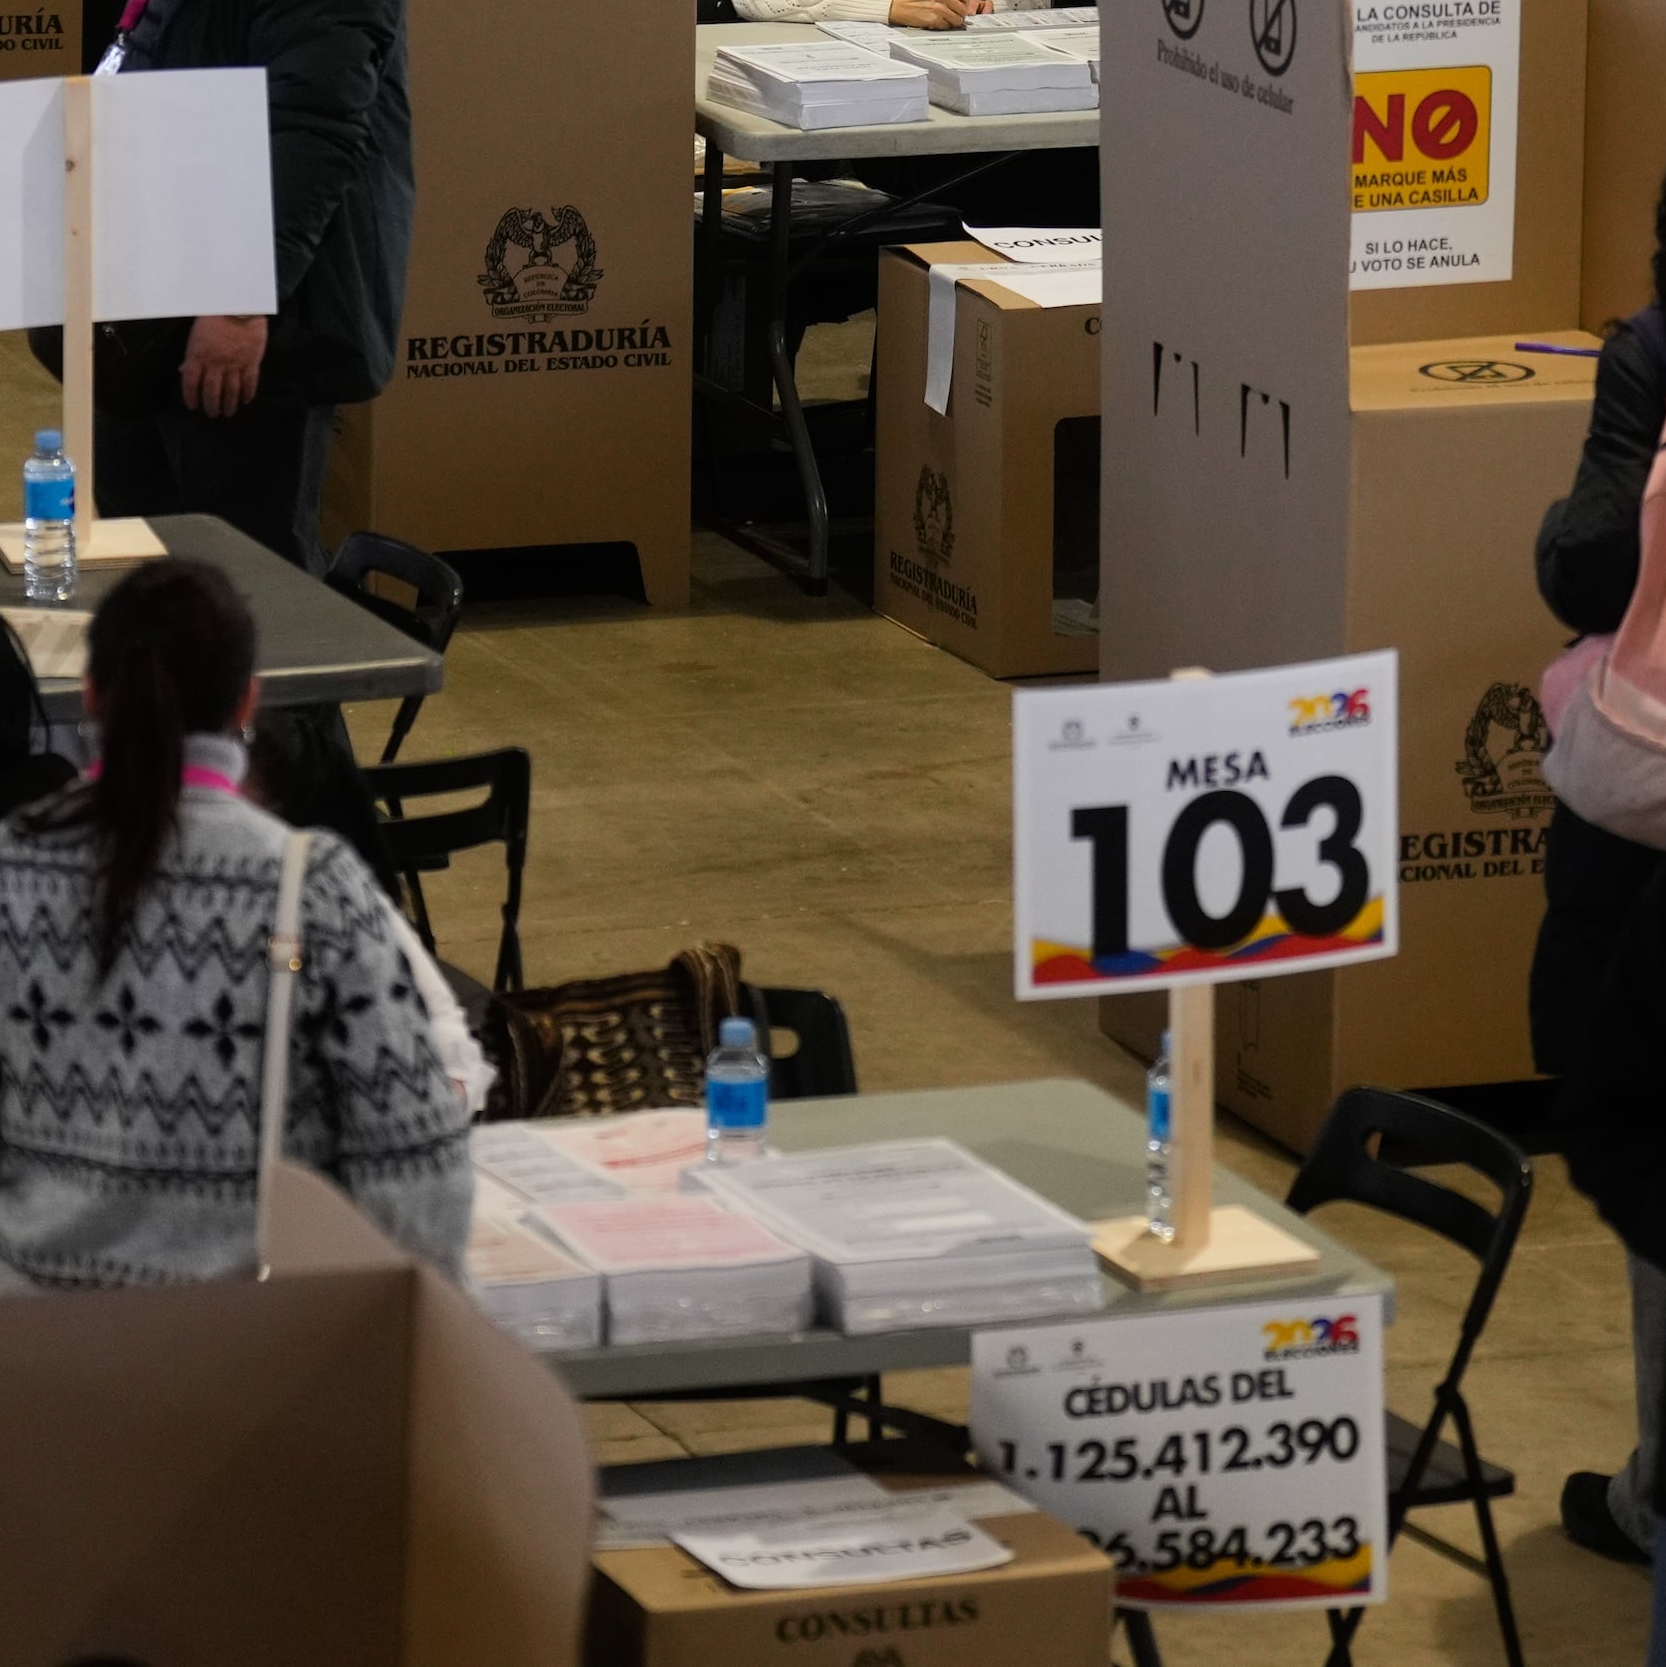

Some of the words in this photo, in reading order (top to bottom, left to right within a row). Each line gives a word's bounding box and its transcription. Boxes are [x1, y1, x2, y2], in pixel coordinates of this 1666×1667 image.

[1357, 8, 1378, 21] LA
[1384, 3, 1472, 19] CONSULTA
[1480, 1, 1501, 15] DE
[21, 38, 62, 50] CIVIL
[1352, 89, 1478, 164] NO
[407, 319, 671, 361] REGISTRADURÍA
[407, 362, 498, 378] NACIONAL
[505, 360, 539, 372] DEL
[548, 356, 617, 370] ESTADO
[624, 353, 671, 367] CIVIL
[1166, 750, 1269, 790] MESA
[1071, 775, 1369, 956] 103
[1064, 1373, 1222, 1419] CÉDULAS
[1232, 1369, 1293, 1401] DEL
[999, 1417, 1359, 1480] 1.125.412.390
[1150, 1485, 1207, 1523] AL
[1077, 1516, 1359, 1571] 6.584.233
[777, 1597, 978, 1643] CONSULTAS
